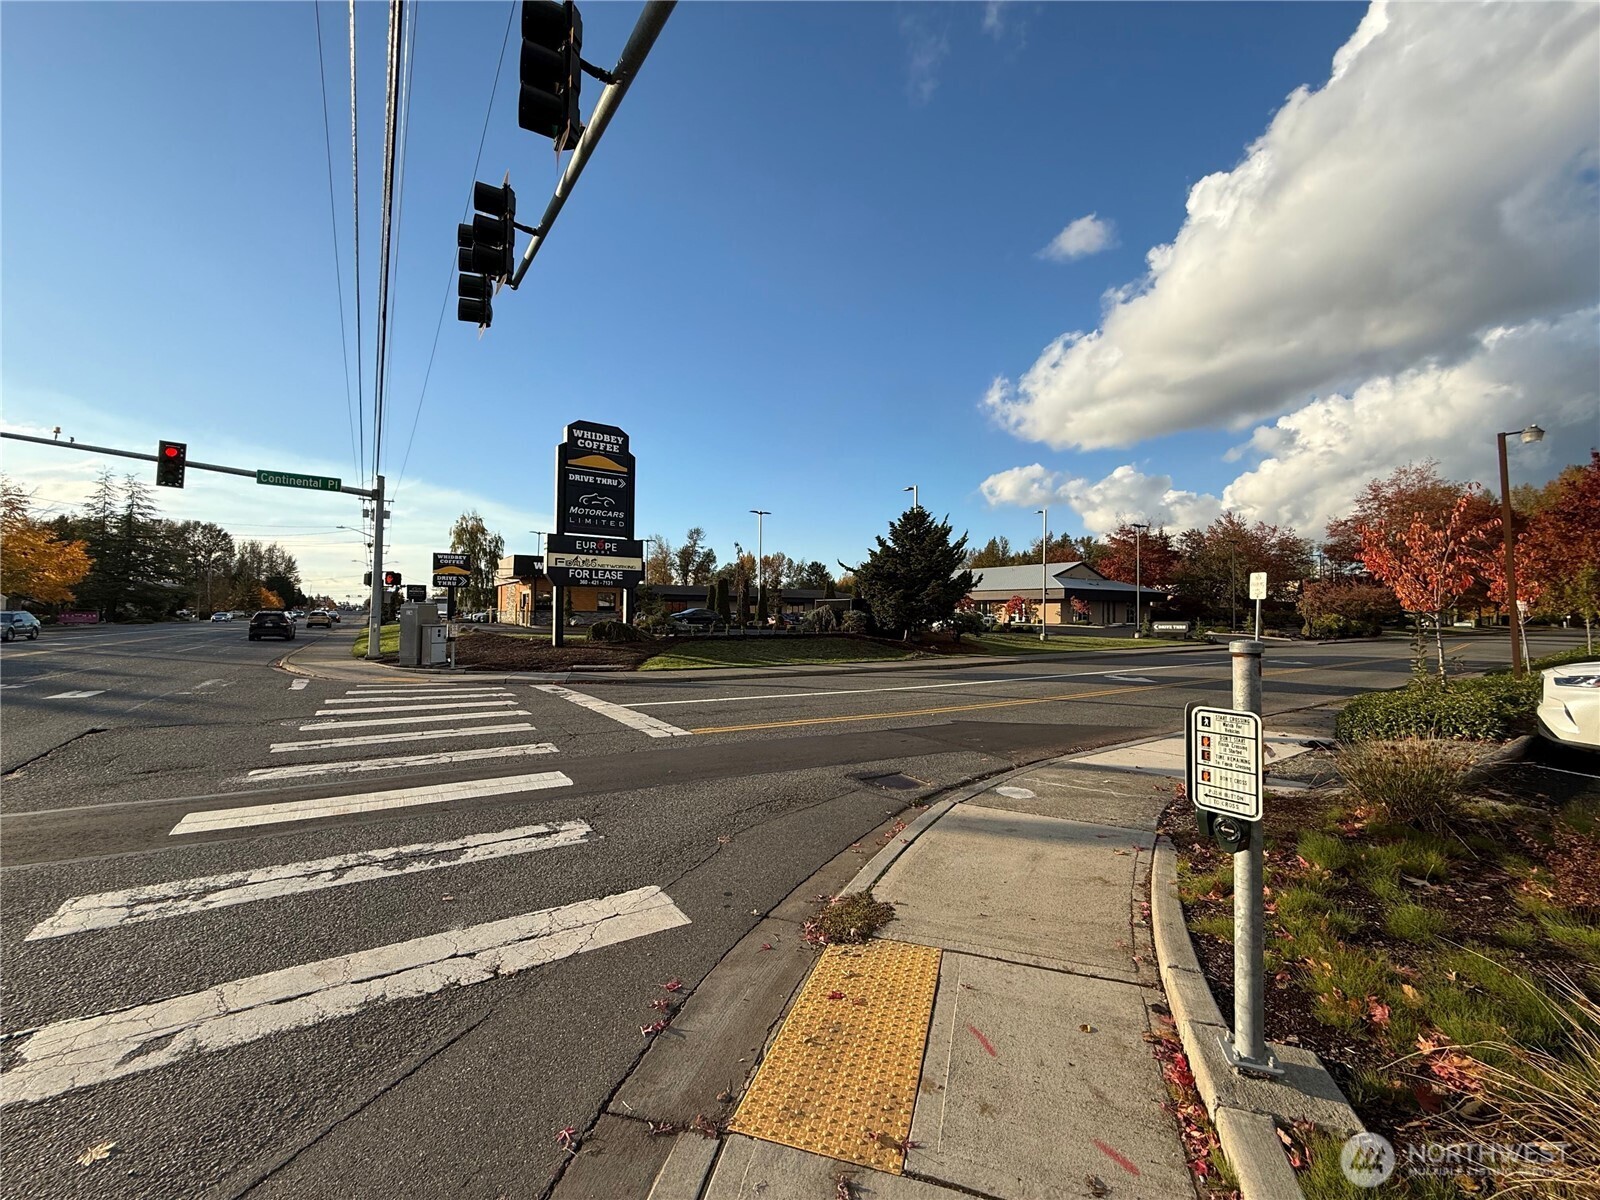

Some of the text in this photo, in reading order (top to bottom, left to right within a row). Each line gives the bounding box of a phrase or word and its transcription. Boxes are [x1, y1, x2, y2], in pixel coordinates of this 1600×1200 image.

[572, 428, 624, 444] WHIDBEY
[577, 439, 620, 452] COFFEE
[260, 472, 338, 489] Continental Pl
[568, 474, 618, 486] DRIVE THRU
[569, 516, 624, 527] LIMITED
[576, 540, 618, 552] EUROPE
[568, 569, 623, 580] FOR LEASE
[1221, 802, 1239, 810] CROSS
